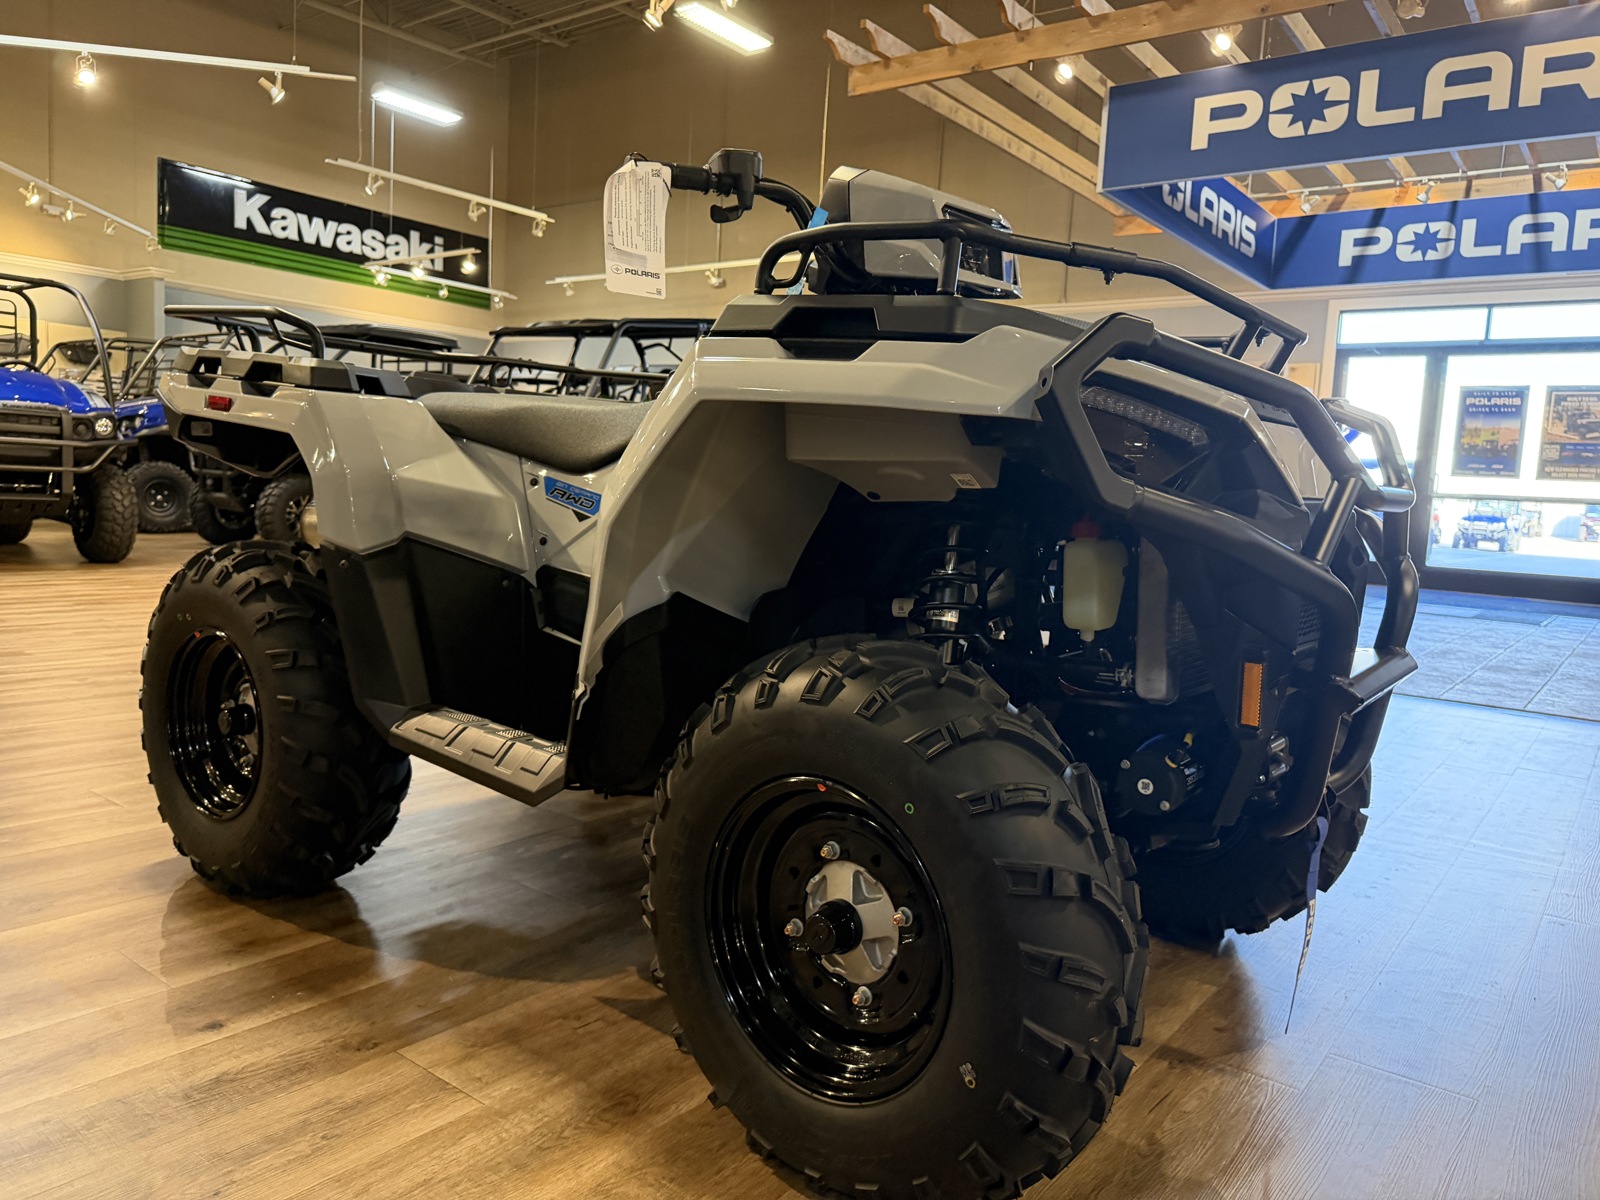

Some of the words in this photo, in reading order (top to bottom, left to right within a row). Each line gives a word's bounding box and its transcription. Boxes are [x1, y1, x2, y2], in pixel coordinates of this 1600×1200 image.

[1191, 36, 1600, 151] POLAR
[233, 188, 444, 272] Kawasaki
[1162, 180, 1257, 258] OLARIS
[625, 268, 660, 279] POLARIS
[1466, 397, 1521, 405] POLARIS
[549, 487, 595, 510] AWD
